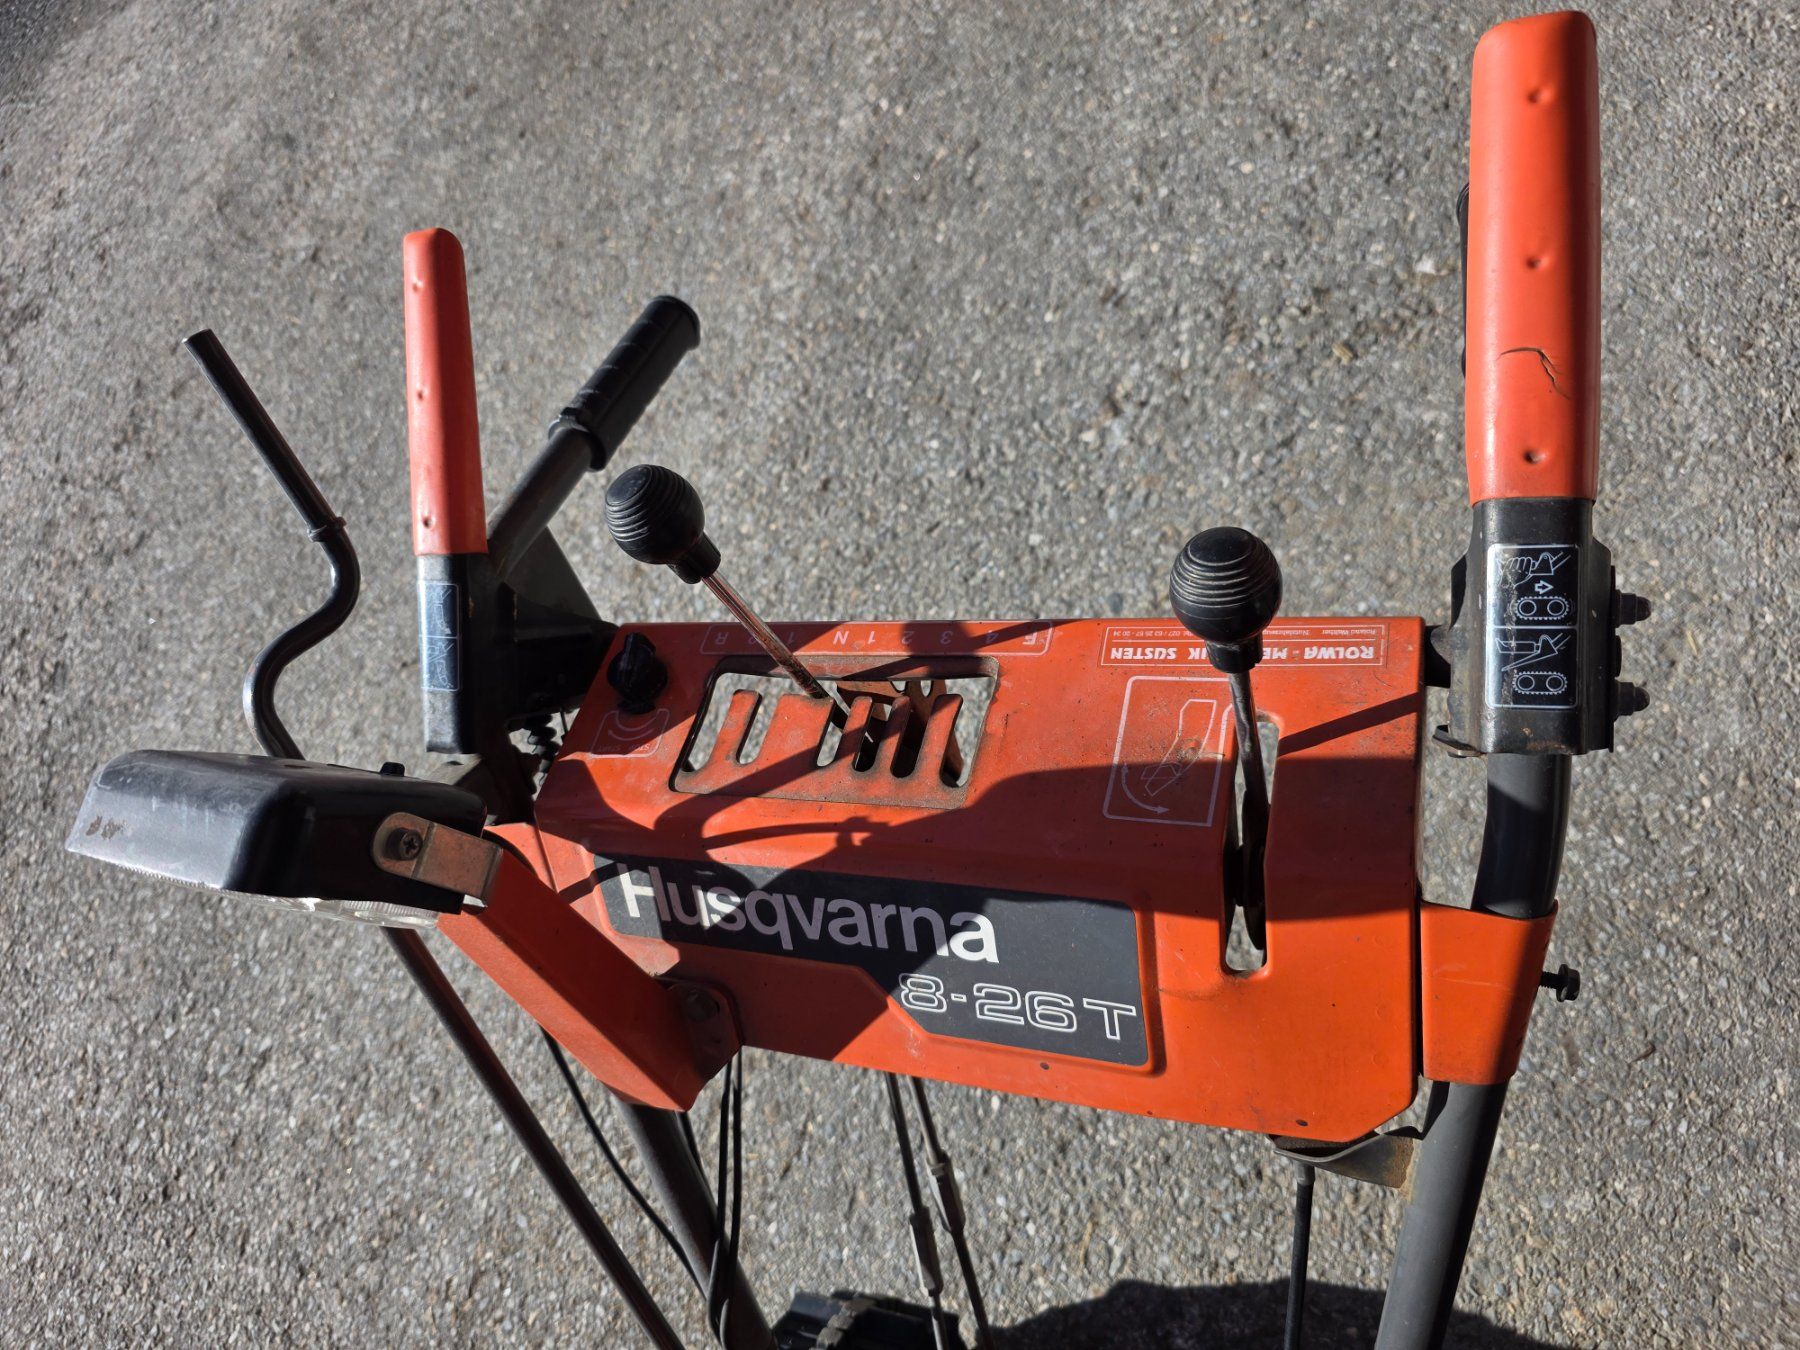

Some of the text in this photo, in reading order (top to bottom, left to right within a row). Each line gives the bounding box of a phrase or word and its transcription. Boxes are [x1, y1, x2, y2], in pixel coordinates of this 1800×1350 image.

[714, 631, 730, 645] R
[832, 630, 850, 645] N
[866, 630, 876, 645] 1
[902, 631, 915, 644] 2
[939, 631, 954, 644] 3
[1022, 632, 1037, 645] F
[1110, 647, 1177, 660] SUSTEN
[1302, 646, 1375, 660] ROLWA
[616, 863, 999, 965] Husqvarna
